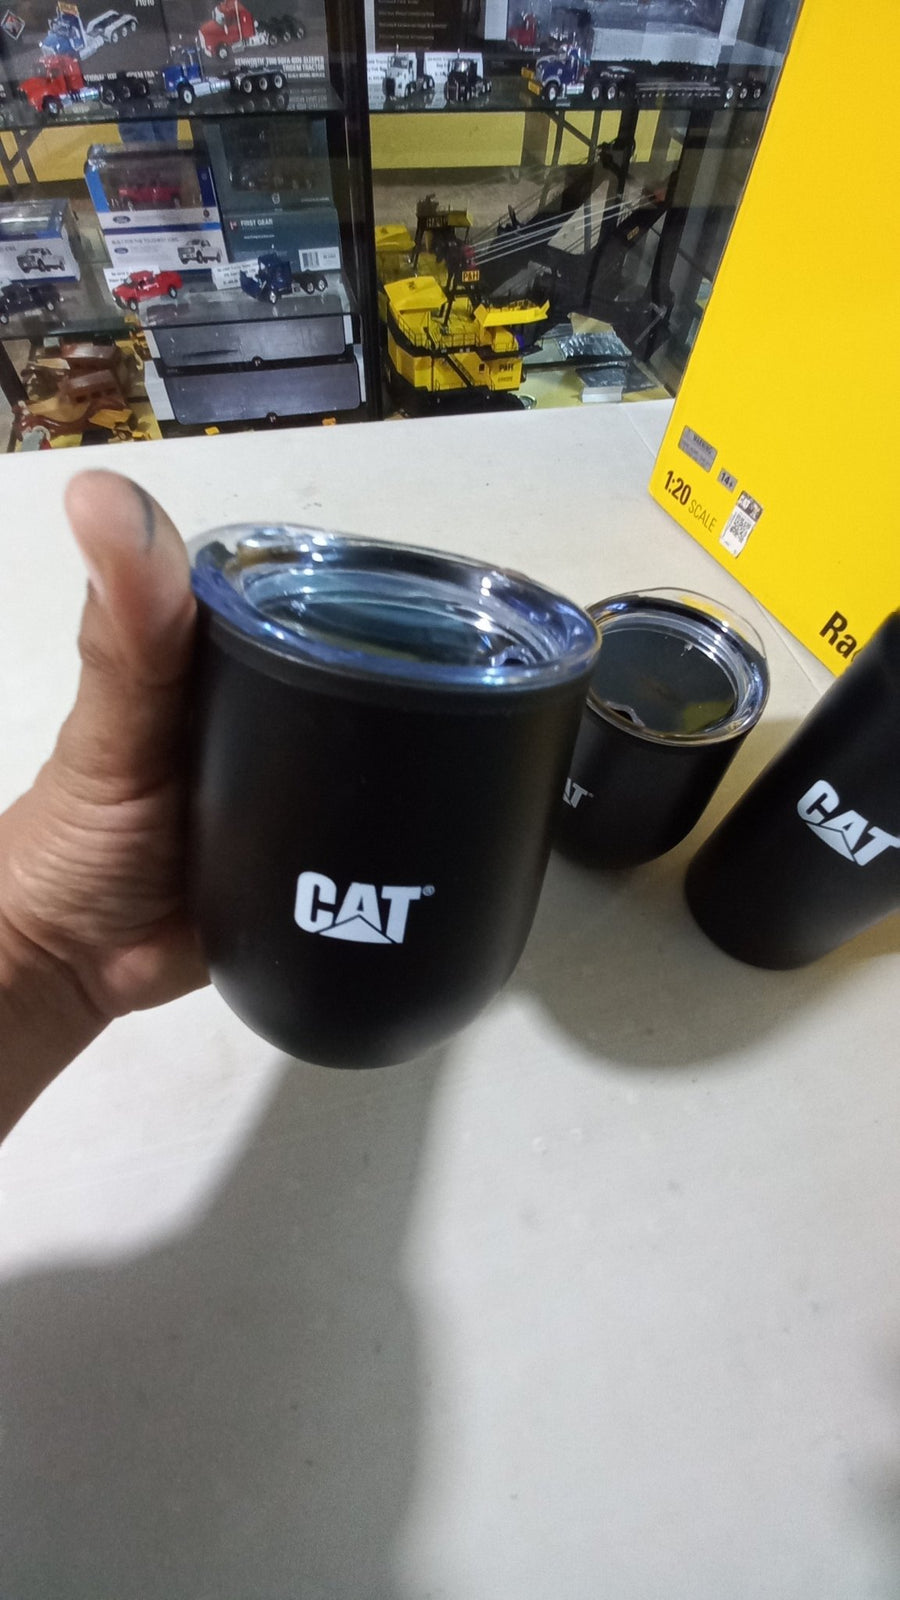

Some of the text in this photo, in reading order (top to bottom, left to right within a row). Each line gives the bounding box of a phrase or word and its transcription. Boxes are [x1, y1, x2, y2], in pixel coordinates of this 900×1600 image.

[240, 218, 256, 228] FIRST
[720, 471, 734, 489] 14+
[664, 469, 692, 506] 1:20
[687, 498, 718, 533] SCALE
[797, 779, 900, 867] CAT
